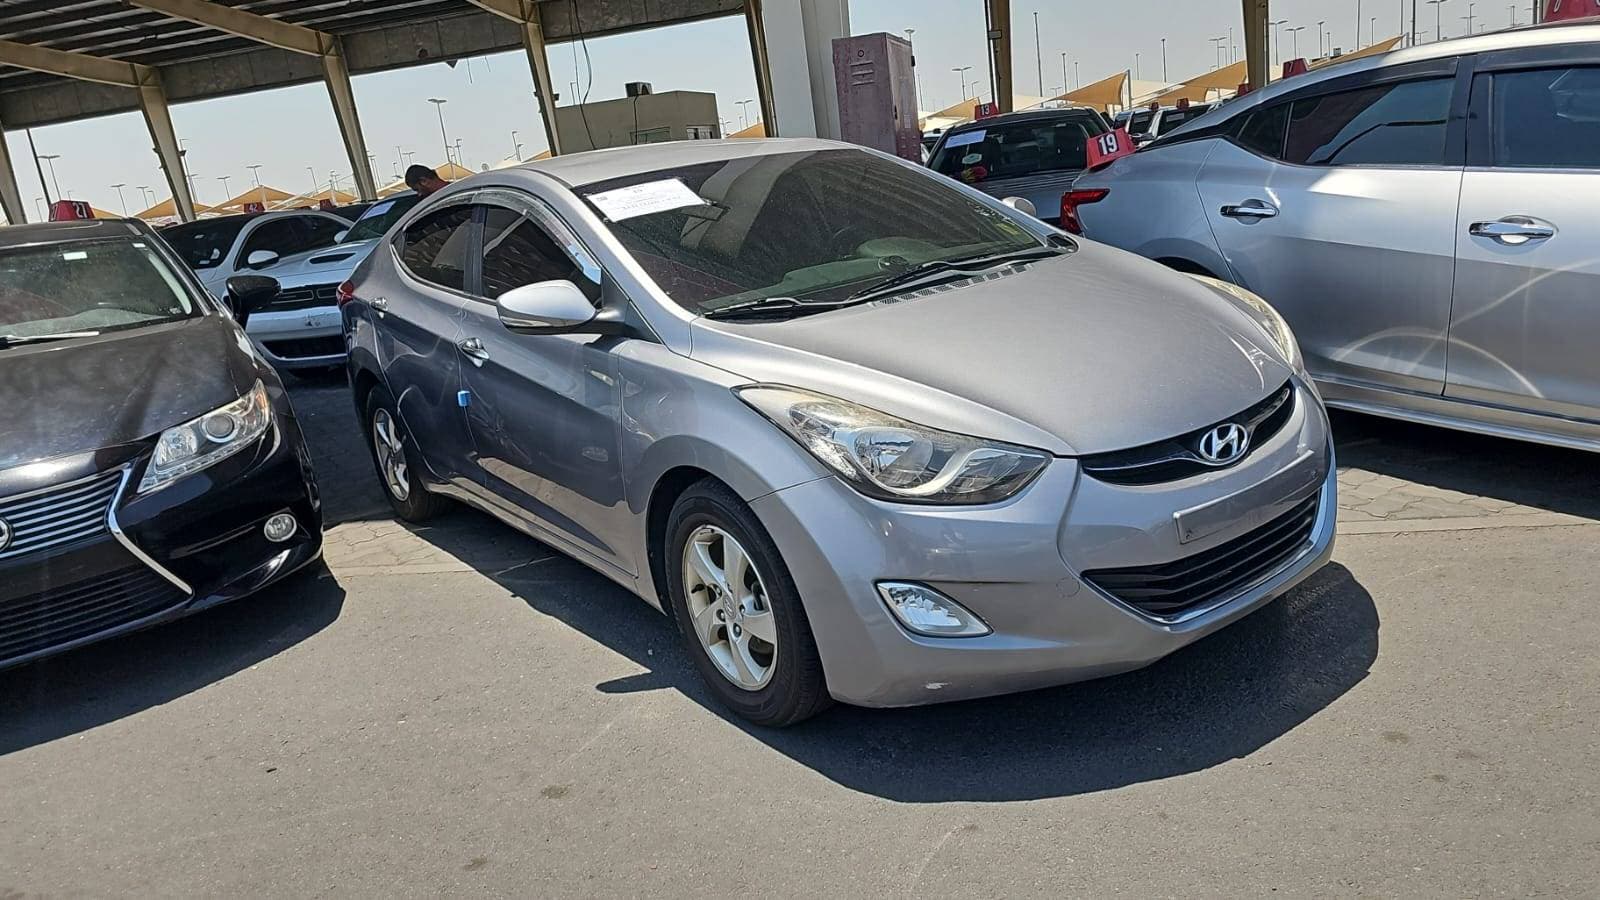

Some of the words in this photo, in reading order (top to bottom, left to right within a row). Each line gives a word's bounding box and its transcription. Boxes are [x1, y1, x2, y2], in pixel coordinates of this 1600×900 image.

[980, 104, 990, 116] 13
[1098, 133, 1118, 155] 19
[72, 202, 88, 219] 27
